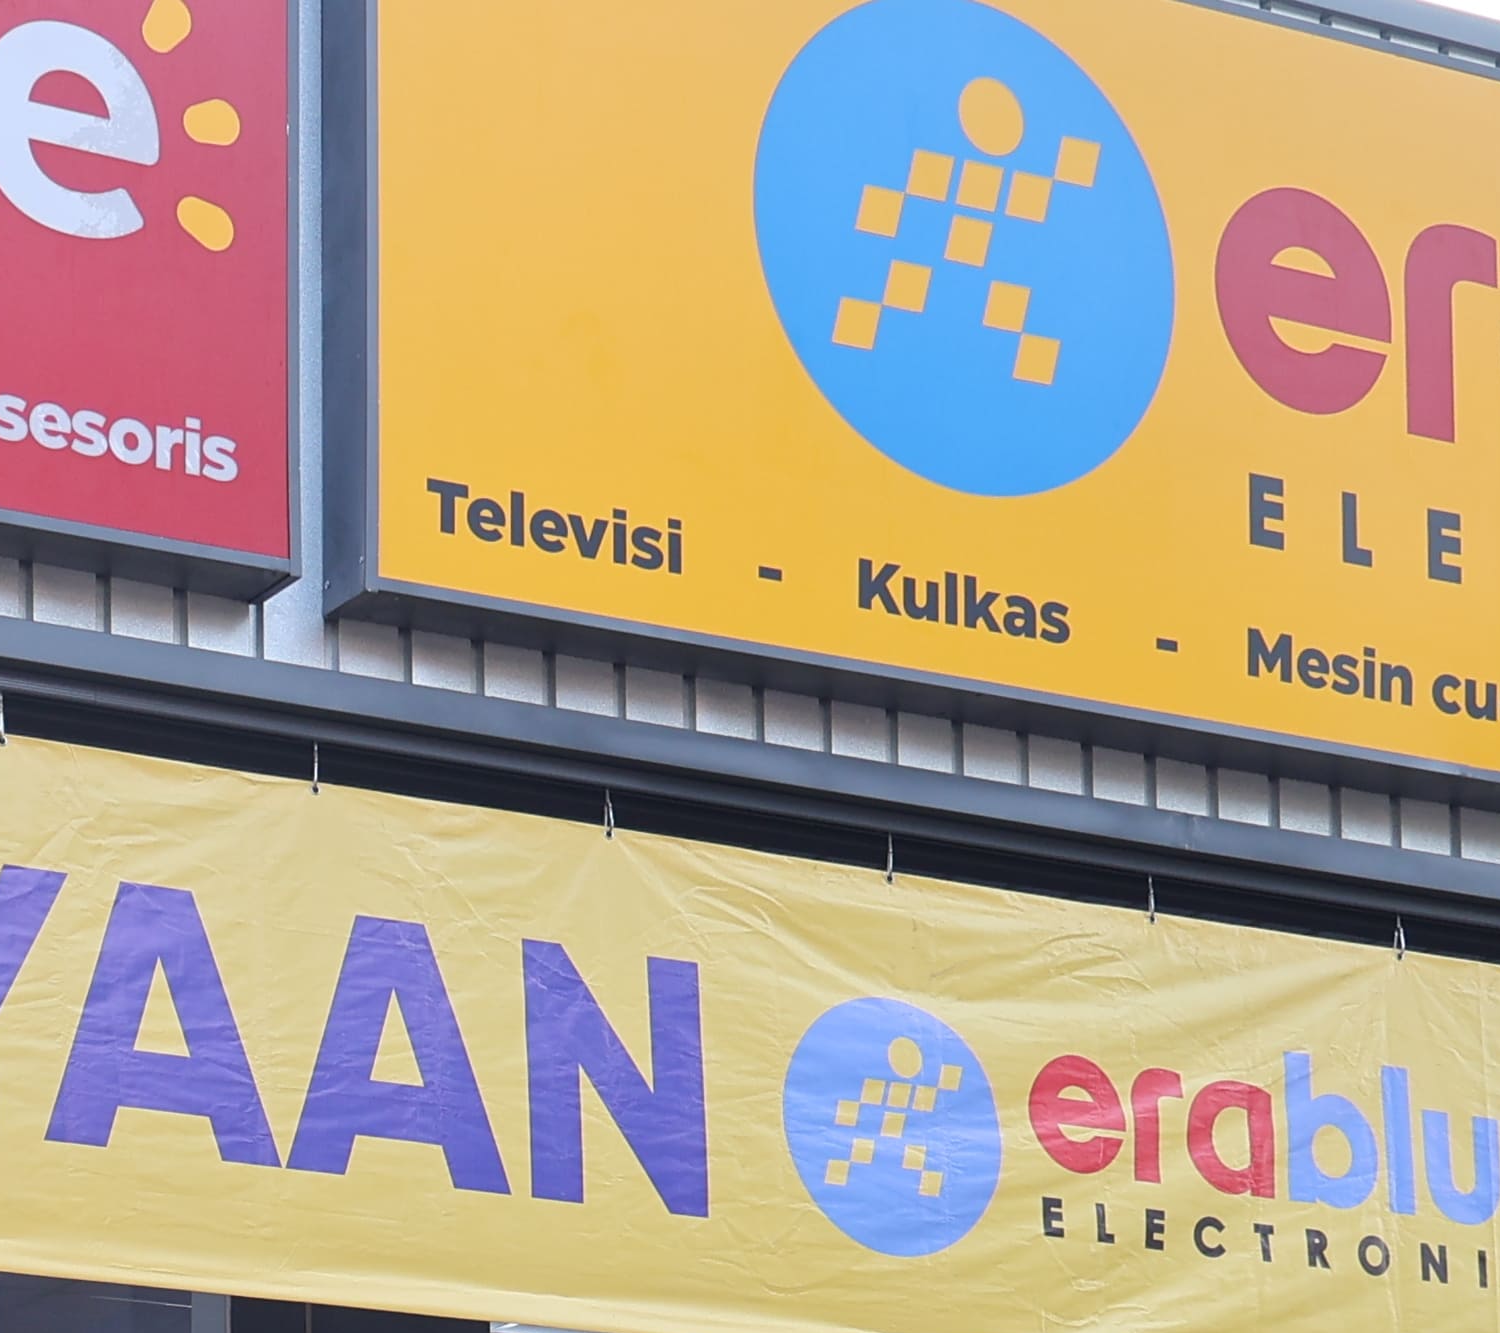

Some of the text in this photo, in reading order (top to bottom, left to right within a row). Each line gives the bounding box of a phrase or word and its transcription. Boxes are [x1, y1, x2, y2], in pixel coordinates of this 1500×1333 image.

[427, 478, 683, 575] Televisi
[857, 558, 1071, 645] Kulkas
[1247, 628, 1413, 705] Mesin
